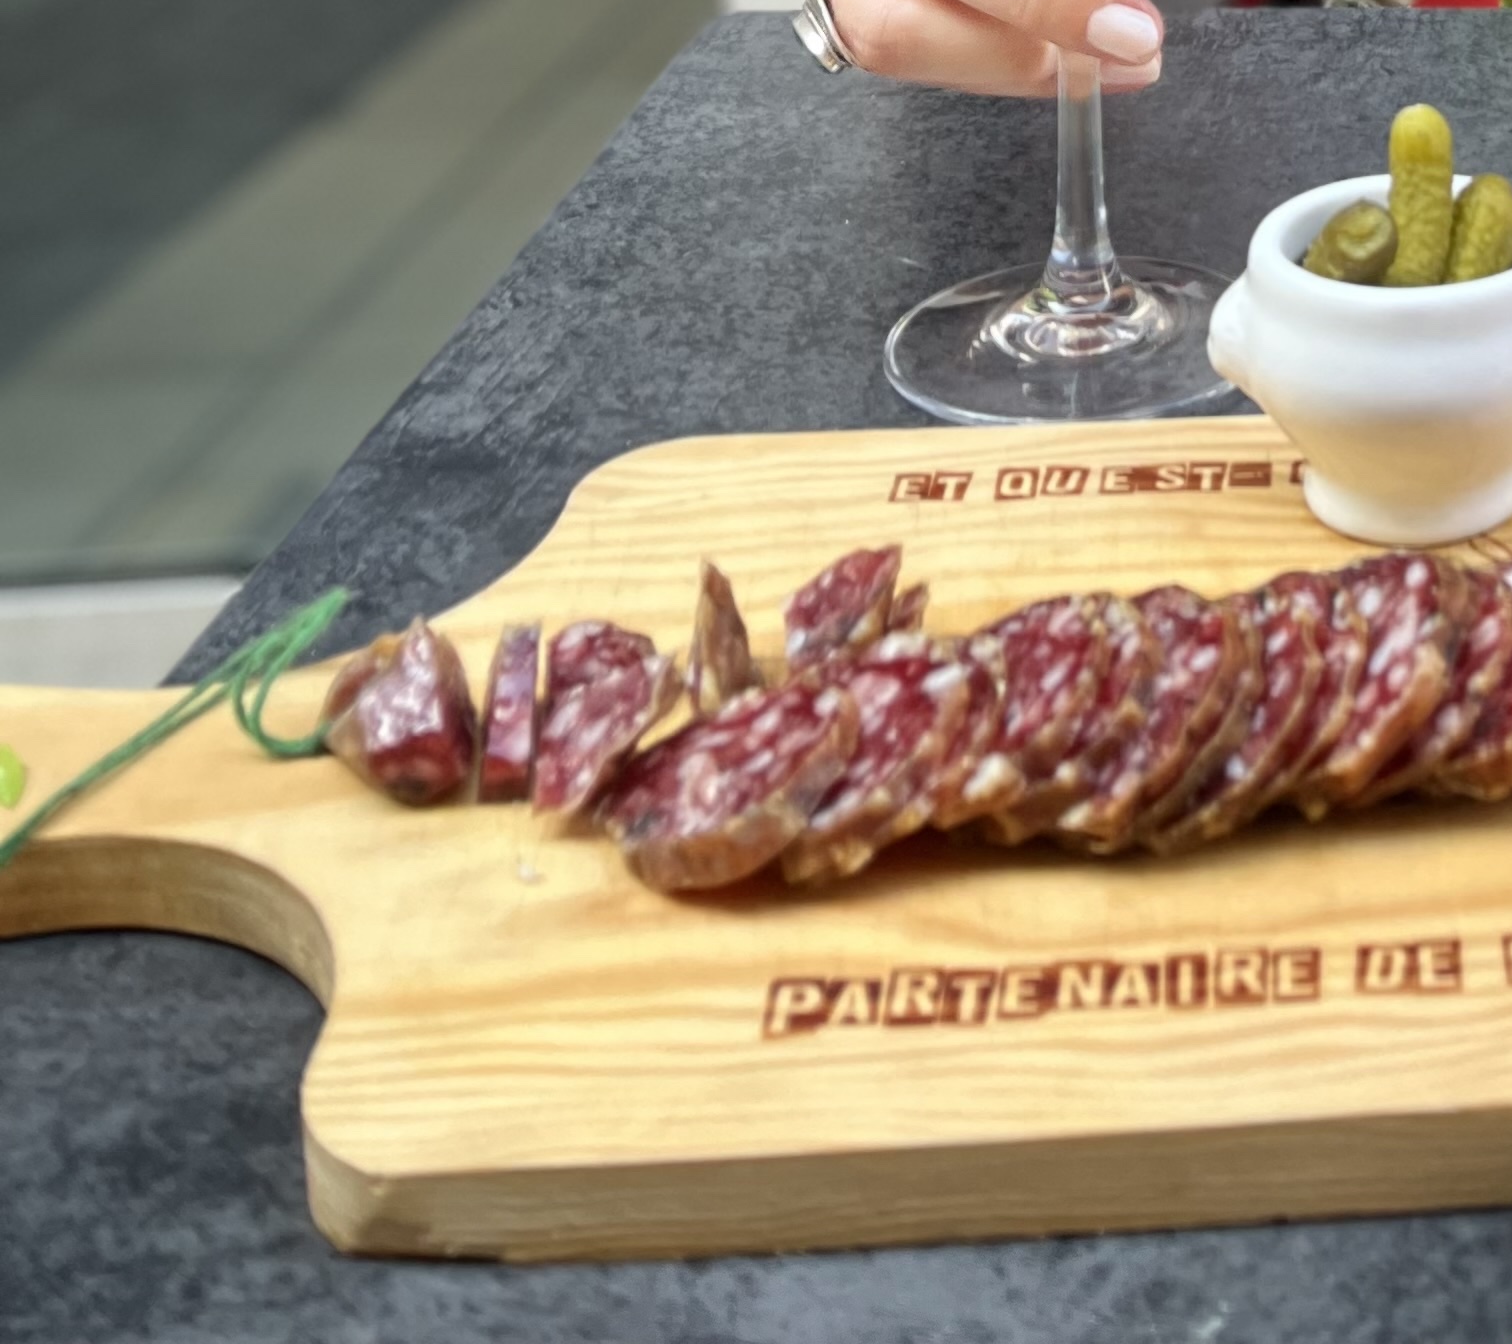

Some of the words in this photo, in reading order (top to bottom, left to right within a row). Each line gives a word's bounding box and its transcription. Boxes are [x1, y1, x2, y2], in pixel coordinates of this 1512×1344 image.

[889, 469, 973, 502] ET
[762, 946, 1322, 1040] PARTENAIRE
[1356, 938, 1463, 996] DE
